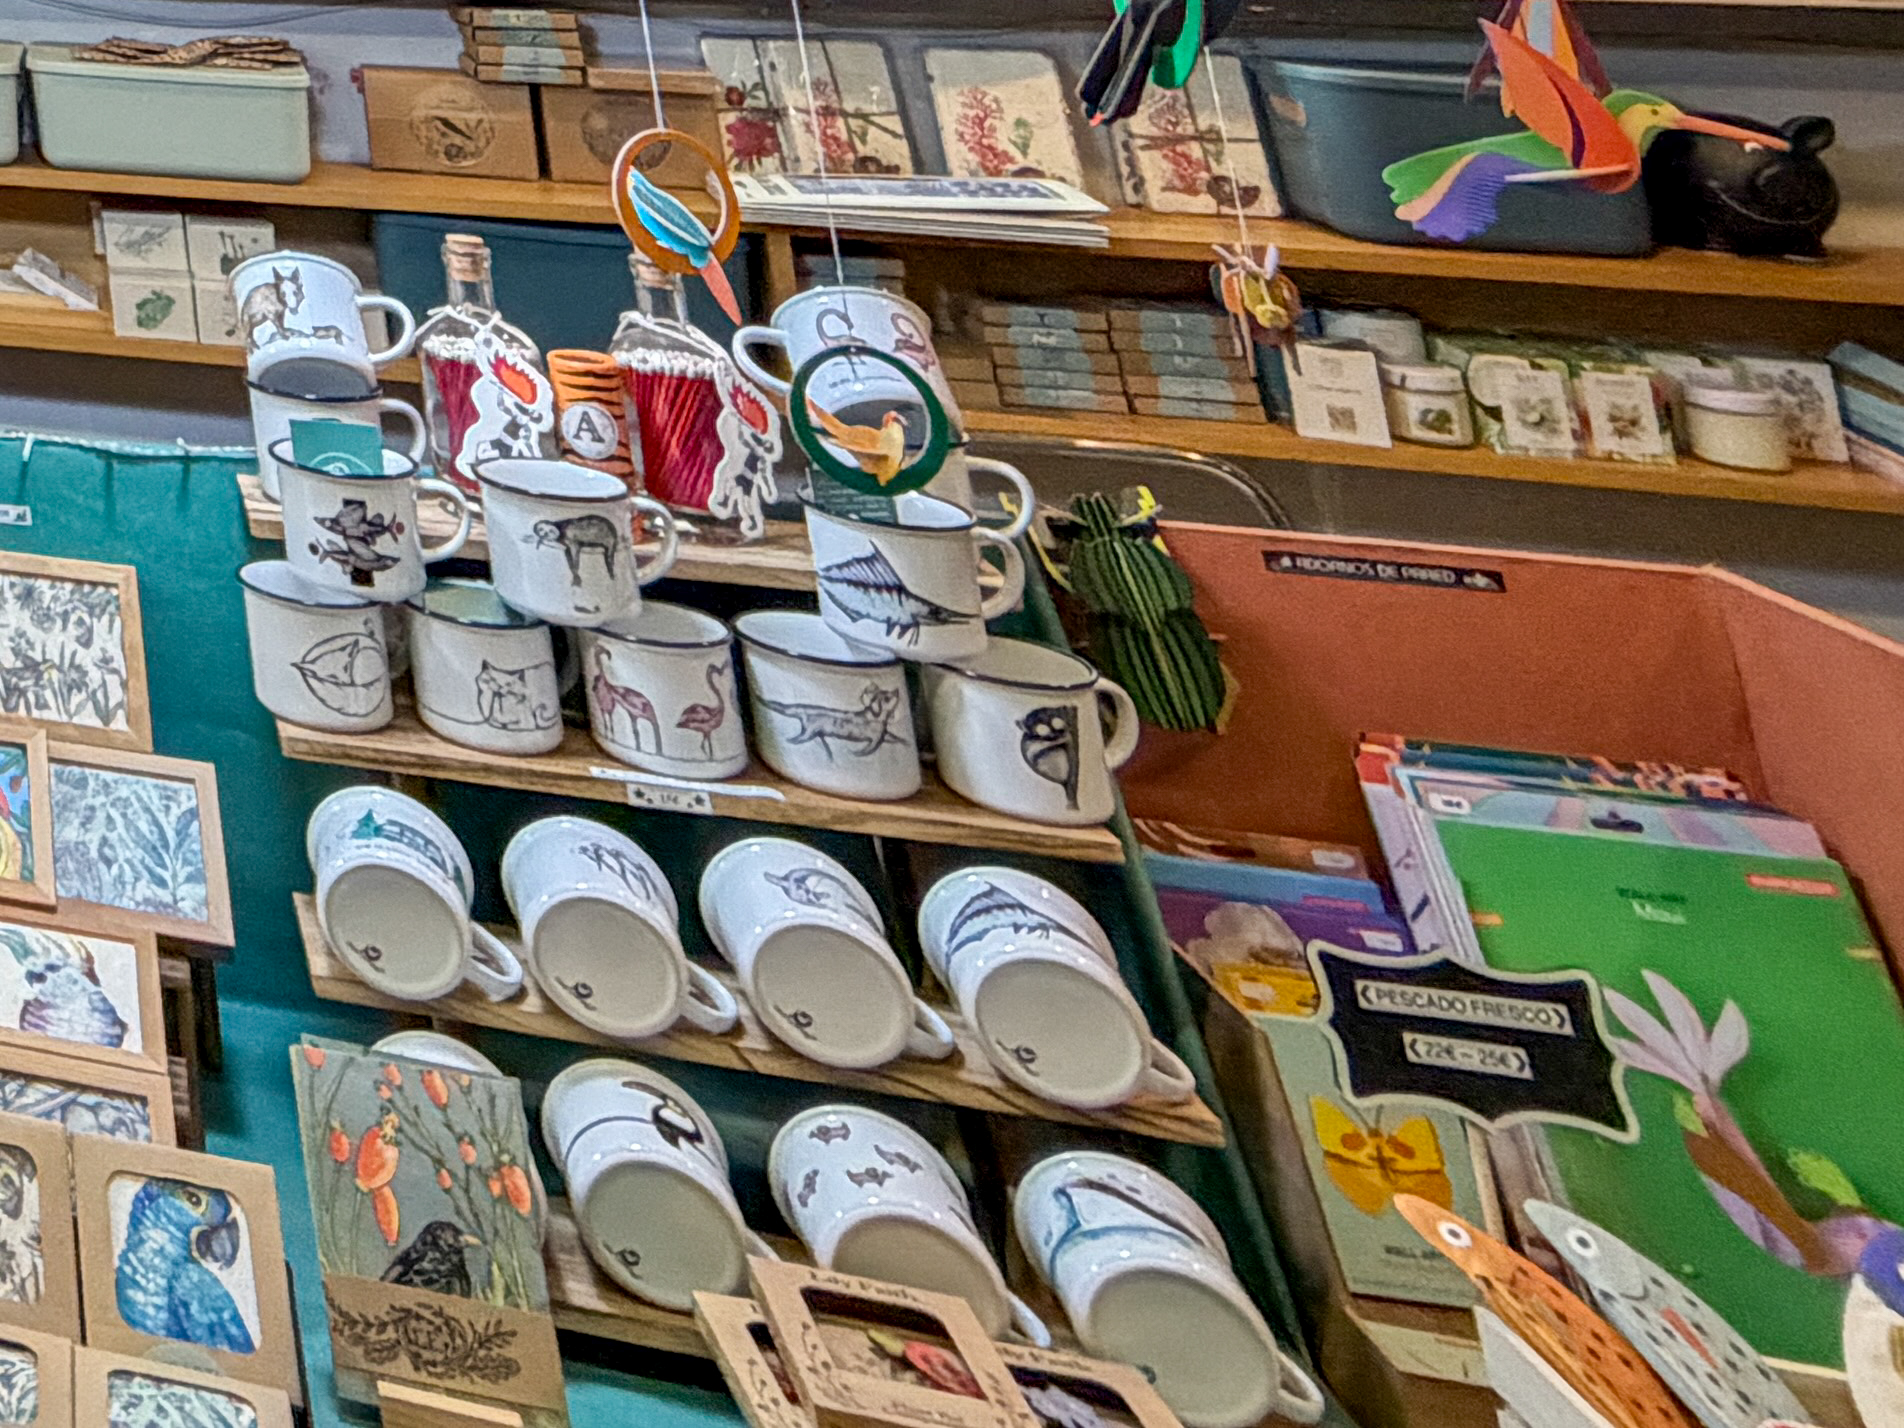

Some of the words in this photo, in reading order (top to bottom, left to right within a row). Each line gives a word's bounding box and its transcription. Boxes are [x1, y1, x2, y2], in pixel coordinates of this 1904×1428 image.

[566, 410, 606, 445] A
[1295, 555, 1376, 576] ADORNOS
[1376, 562, 1399, 579] DE
[1400, 565, 1457, 584] PARED
[1375, 985, 1467, 1014] PESCADO
[1470, 999, 1552, 1026] FRESCO
